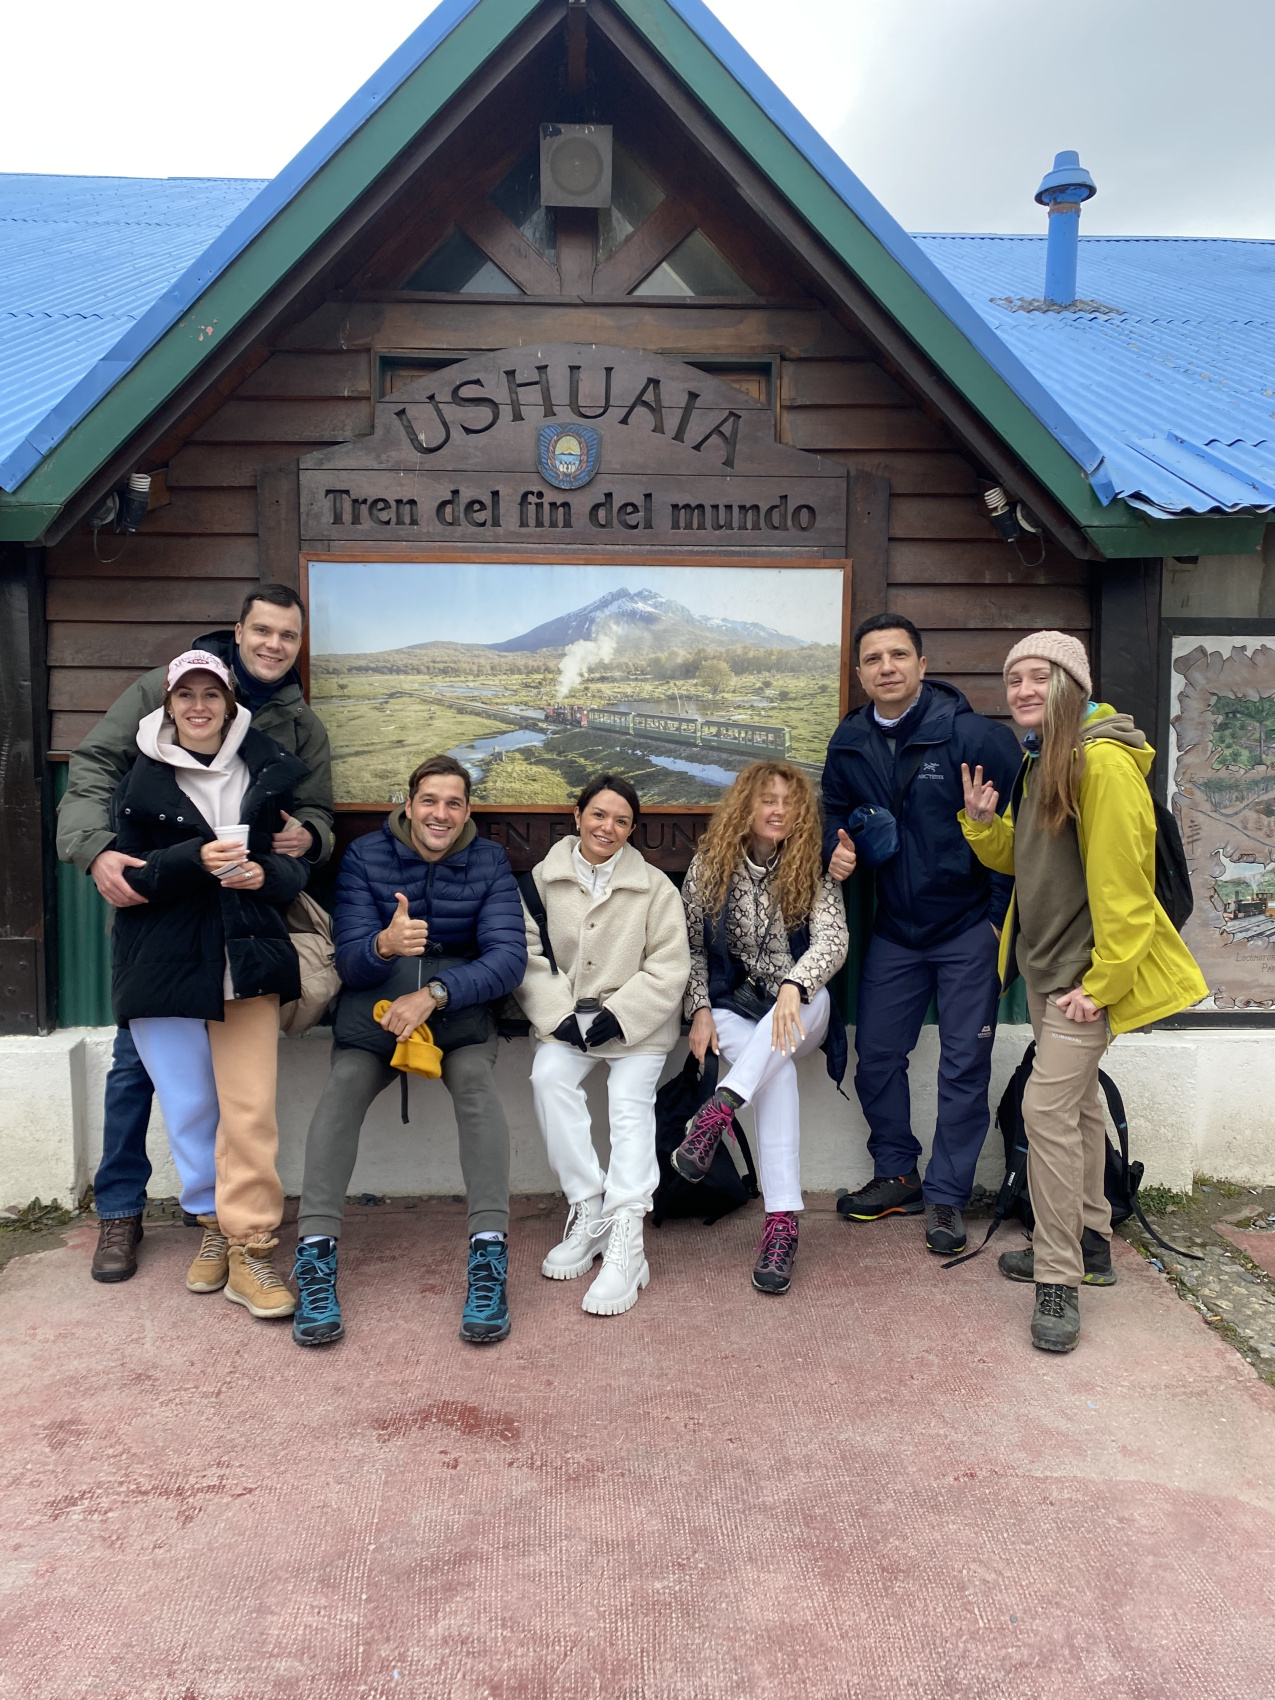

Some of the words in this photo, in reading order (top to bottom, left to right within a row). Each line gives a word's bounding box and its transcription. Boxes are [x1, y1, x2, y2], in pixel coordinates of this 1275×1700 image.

[393, 364, 742, 470] USHUAIA
[324, 488, 420, 526] Tren
[435, 489, 503, 528] del
[518, 490, 574, 529] fin
[588, 492, 654, 531] del
[671, 494, 817, 533] mundo
